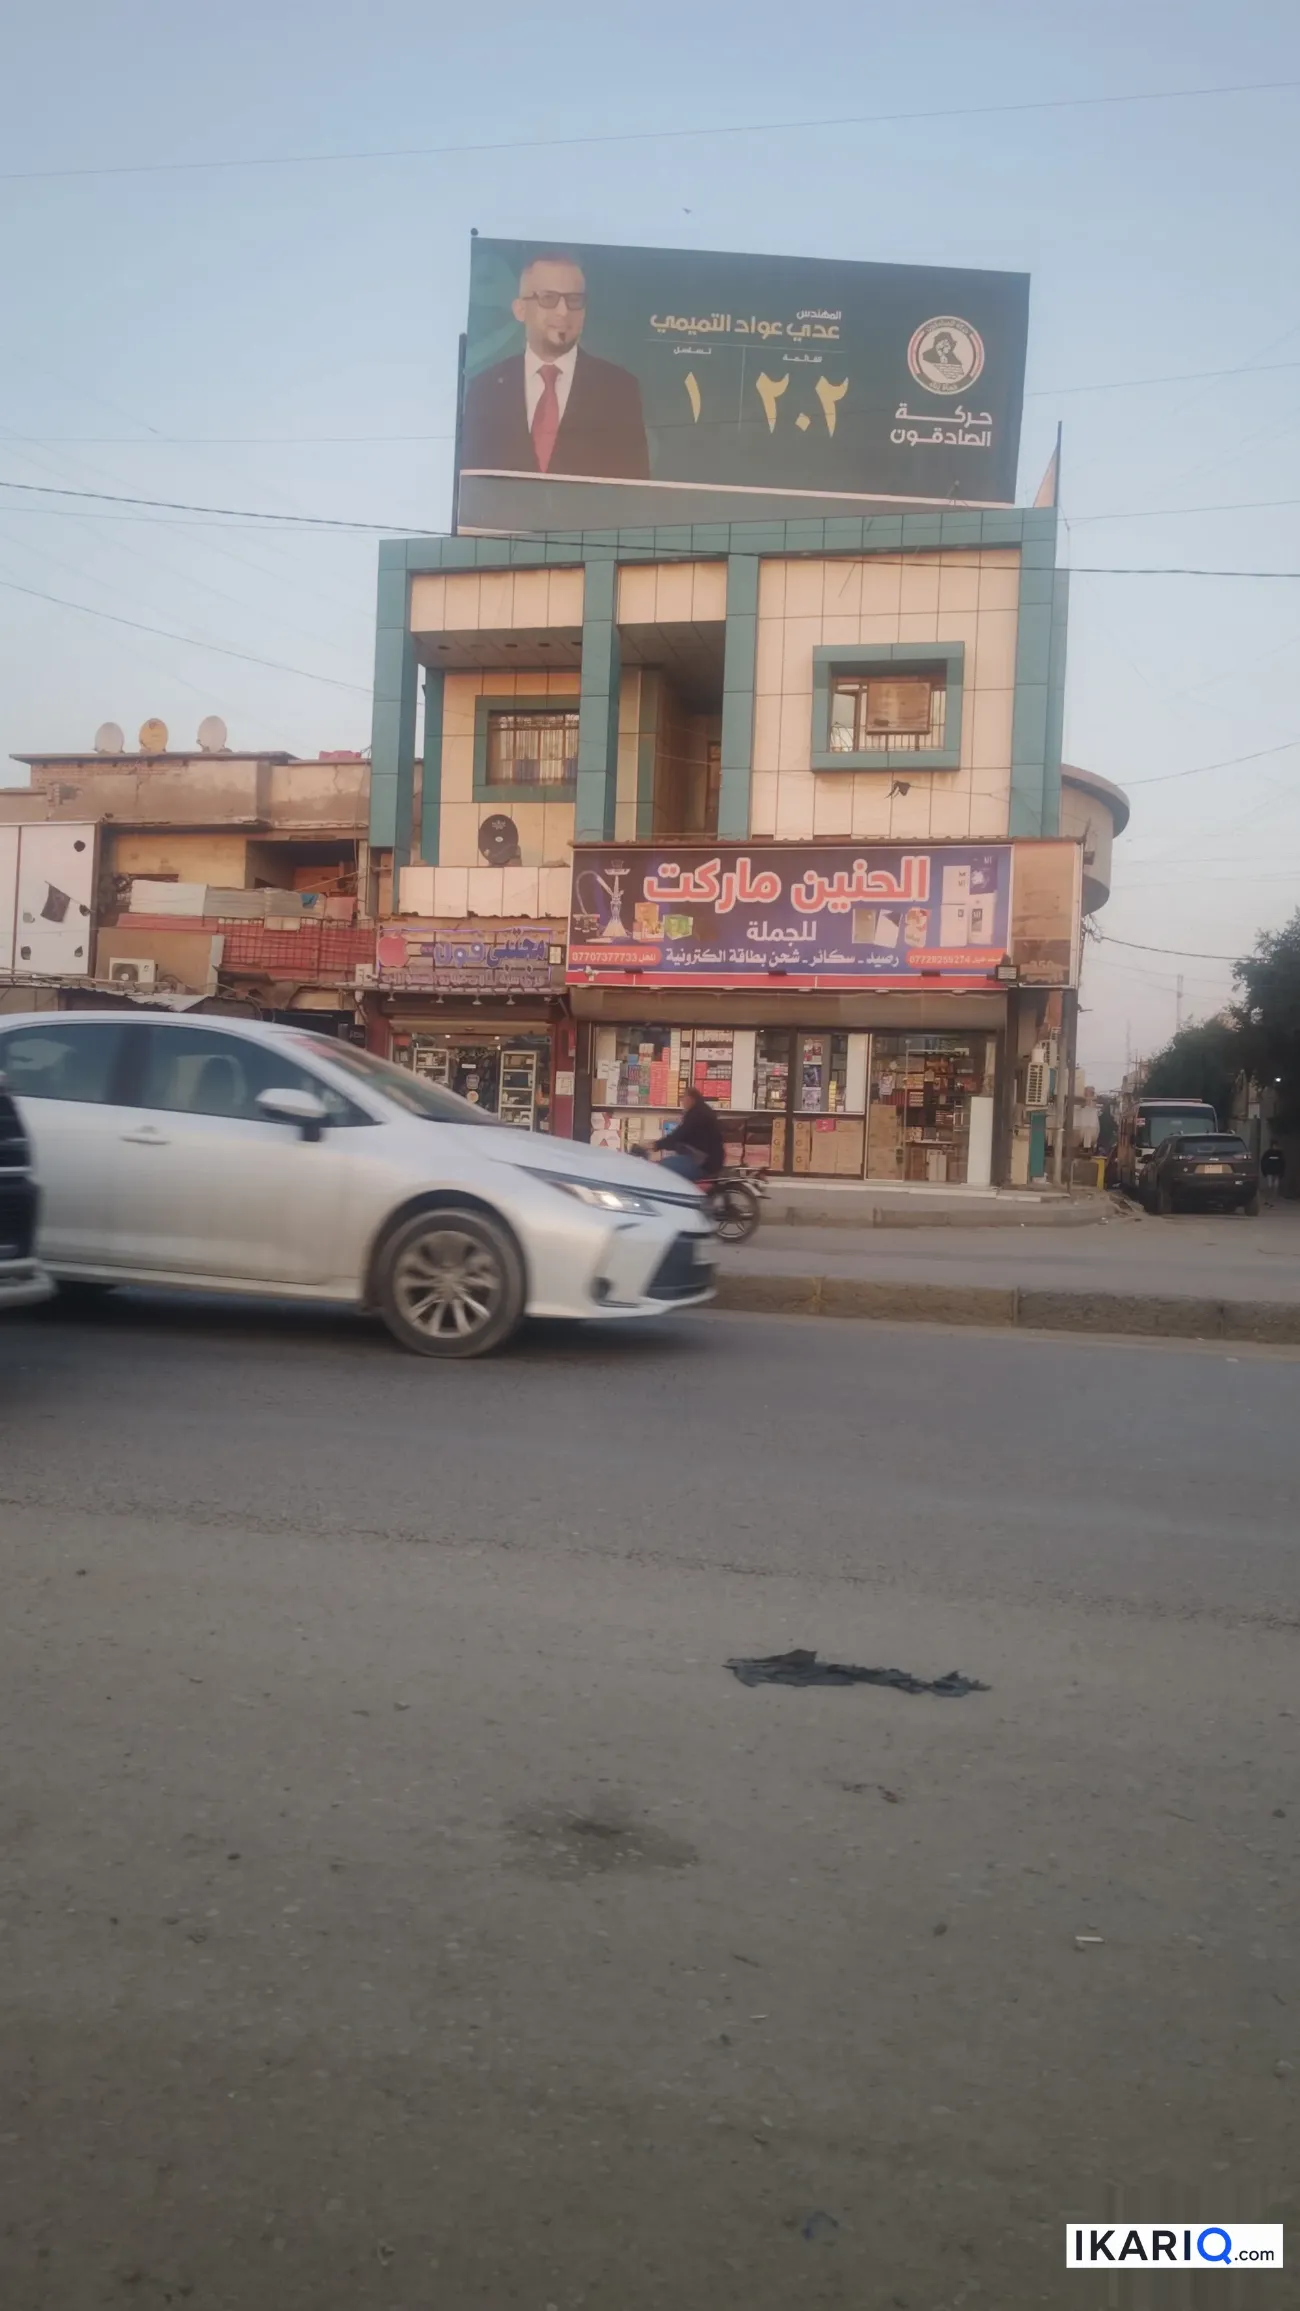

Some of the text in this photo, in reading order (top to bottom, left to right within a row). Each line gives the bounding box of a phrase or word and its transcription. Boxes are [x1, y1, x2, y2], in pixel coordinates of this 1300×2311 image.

[796, 308, 842, 320] المهندس
[650, 312, 840, 341] عدي عواد التميمي
[684, 371, 701, 424] ١
[755, 371, 849, 438] ٢٠٢
[895, 402, 992, 428] حركة
[890, 427, 992, 447] الصادقون
[643, 856, 931, 913] الحنين ماركت
[746, 920, 817, 946] للجملة
[666, 948, 726, 969] الكترونية
[729, 948, 767, 968] بطاقة
[769, 949, 800, 967] شحن
[866, 950, 900, 967] رصيد
